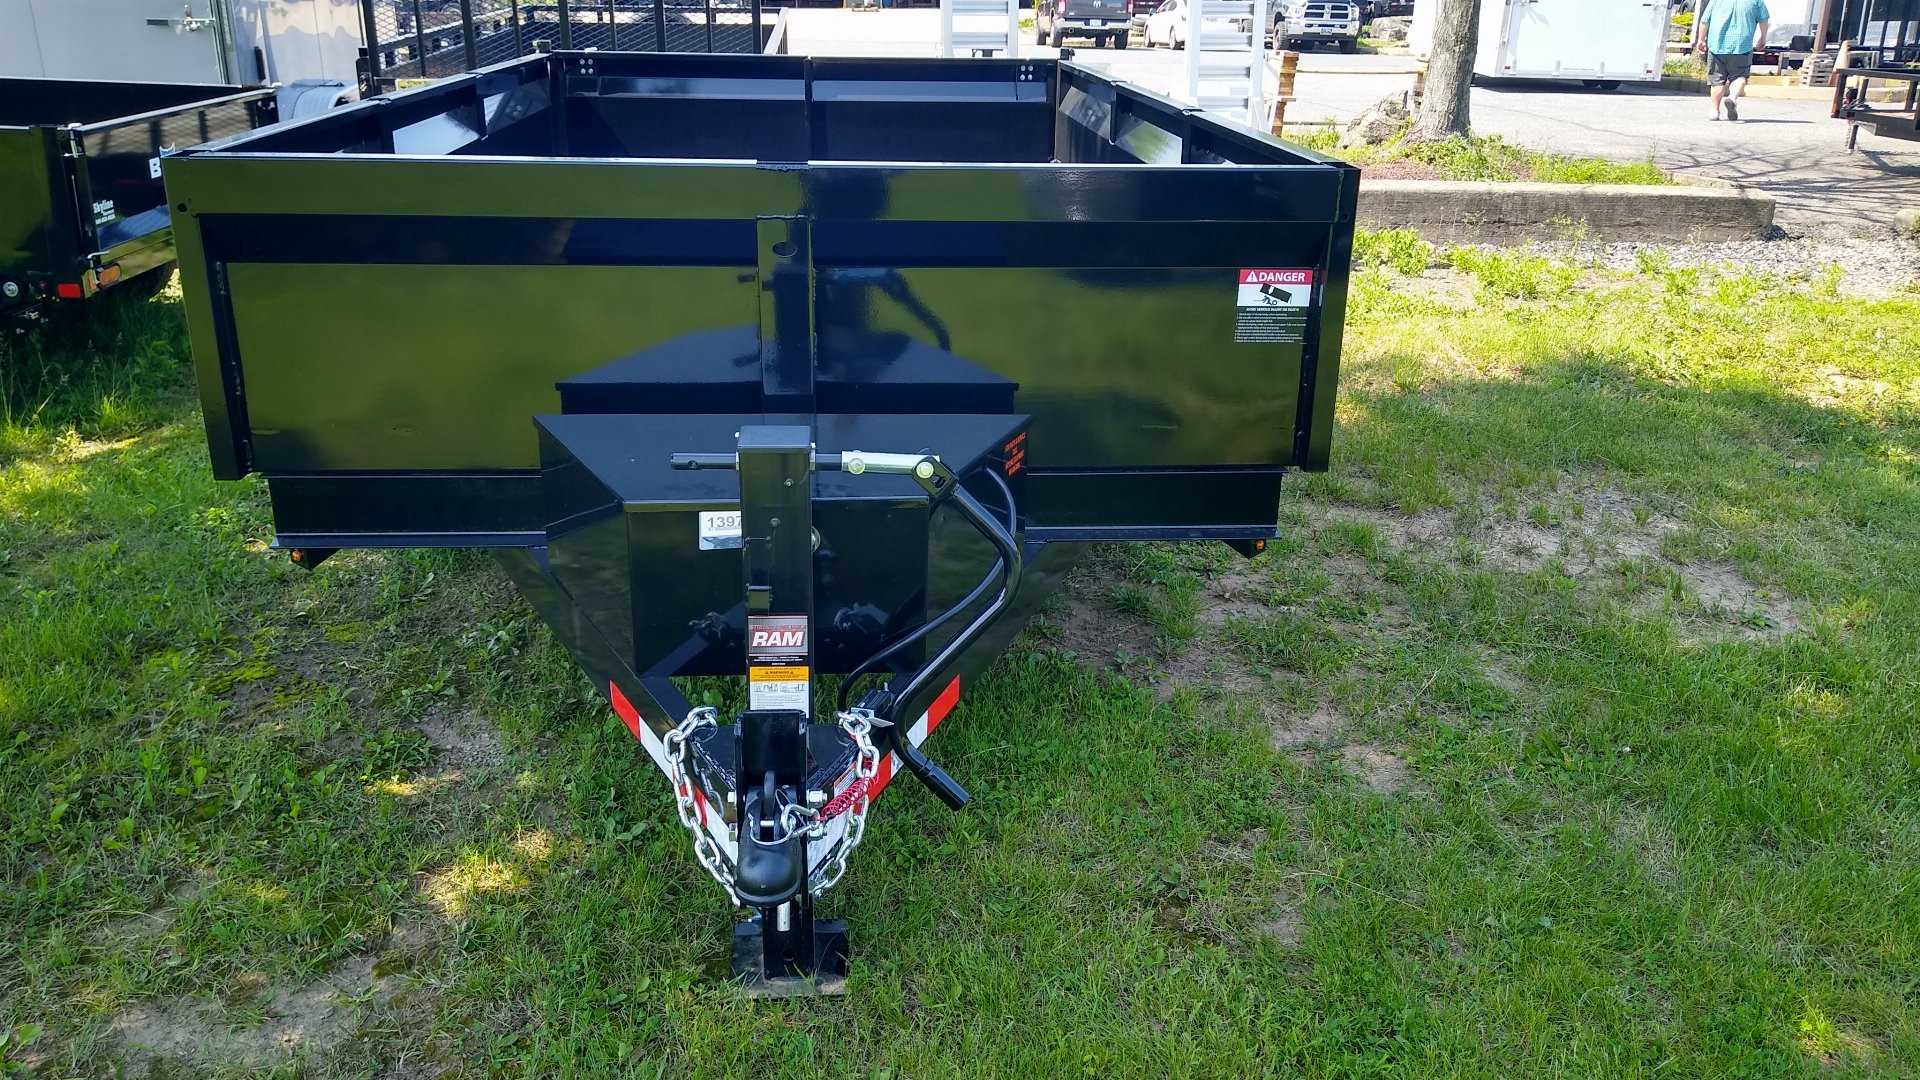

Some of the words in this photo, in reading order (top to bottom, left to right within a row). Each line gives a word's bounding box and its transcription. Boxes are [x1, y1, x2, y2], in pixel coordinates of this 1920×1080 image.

[1259, 272, 1306, 282] DANGER
[707, 515, 741, 527] 1397
[752, 631, 804, 647] RAM
